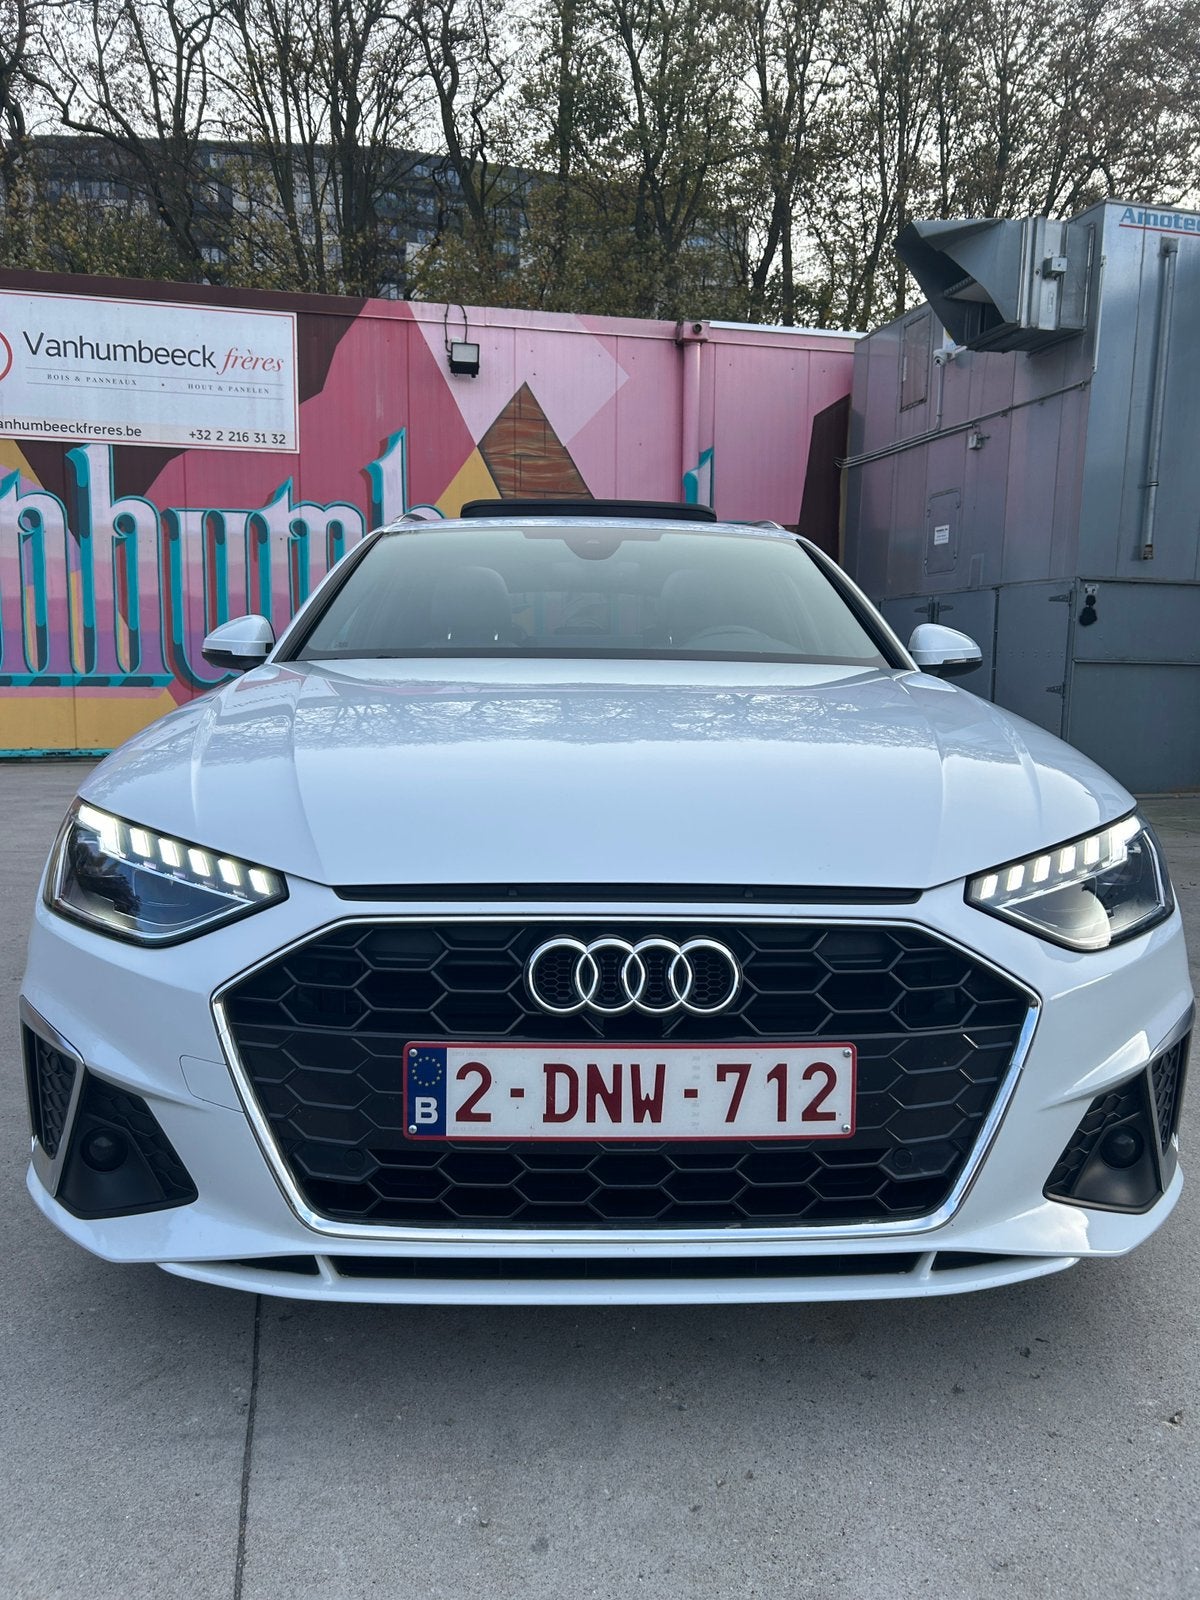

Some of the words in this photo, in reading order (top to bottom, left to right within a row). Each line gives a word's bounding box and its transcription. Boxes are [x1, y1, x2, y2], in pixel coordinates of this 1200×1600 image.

[22, 330, 217, 369] Vanhumbeeck
[216, 346, 285, 376] frères
[47, 373, 70, 381] BOIS
[86, 376, 137, 386] PANNEAUX
[188, 383, 213, 391] HOUT
[189, 429, 212, 441] +32
[216, 430, 224, 441] 2
[228, 431, 249, 443] 216
[254, 433, 267, 444] 31
[271, 434, 286, 444] 32
[415, 1096, 439, 1124] B
